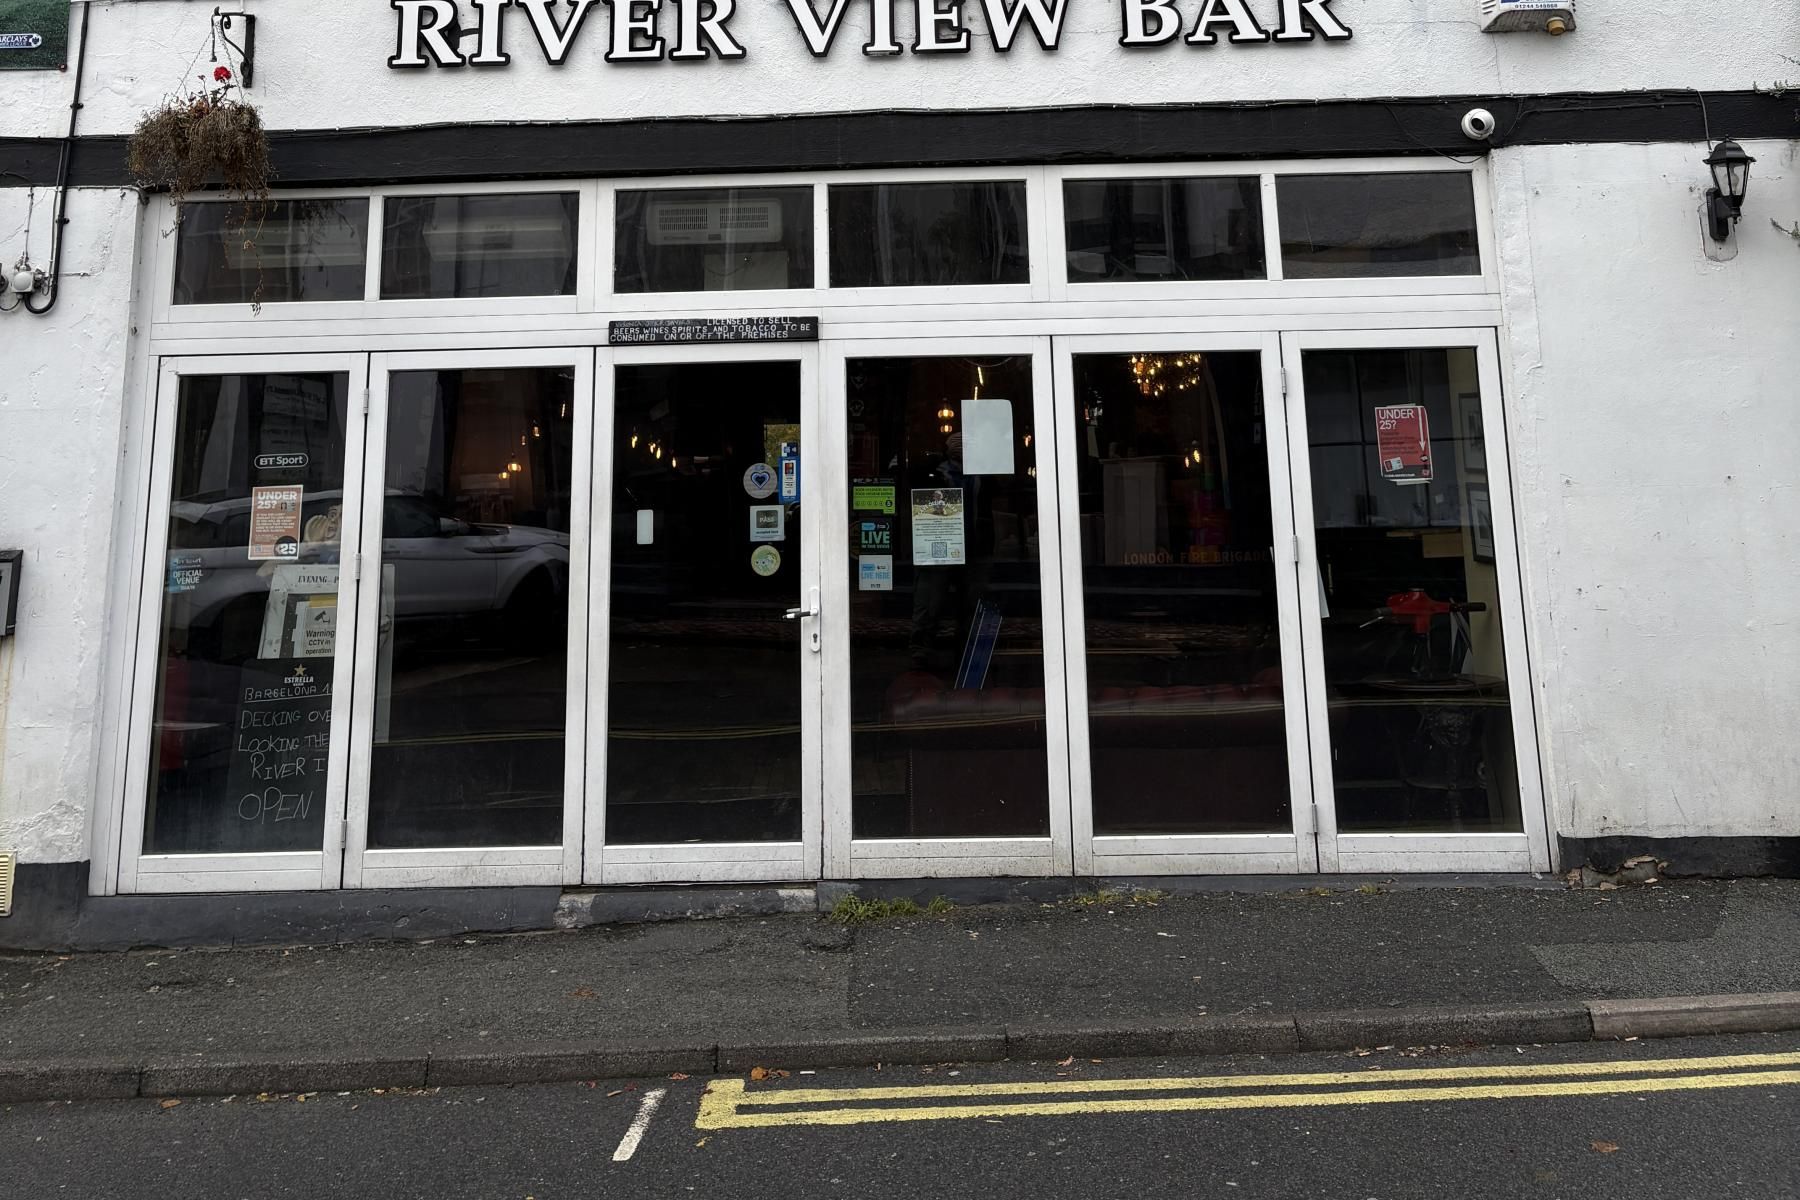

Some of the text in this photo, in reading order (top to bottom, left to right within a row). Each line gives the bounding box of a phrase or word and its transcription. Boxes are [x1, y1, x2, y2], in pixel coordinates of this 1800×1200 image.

[707, 315, 794, 326] LICENSED TO SELL
[614, 327, 641, 335] BEERS
[643, 326, 669, 334] WINES
[671, 325, 709, 333] SPIRITS
[713, 325, 729, 333] AND
[733, 324, 778, 332] TOBACCO
[800, 322, 812, 331] BE
[610, 330, 789, 342] CONSUMED ON OR OFF THE PREMISES
[1379, 408, 1415, 419] UNDER
[1379, 420, 1397, 430] 25?
[260, 455, 303, 466] BT Sport
[257, 491, 298, 501] UNDER
[256, 500, 277, 510] 25?
[861, 531, 890, 544] LIVE
[1124, 551, 1174, 565] LONDON
[1180, 551, 1210, 564] FIRE
[173, 570, 204, 578] OFFICIAL
[298, 575, 328, 584] EVENING
[176, 576, 200, 585] VENUE
[306, 629, 337, 640] Warning
[308, 639, 324, 647] CCTV
[305, 648, 332, 657] operation
[284, 676, 315, 685] ESTRELLA
[240, 709, 333, 730] DECKING OVE
[238, 732, 329, 753] LOOKING THE
[250, 751, 306, 780] RIVER
[238, 785, 314, 825] OPEN
